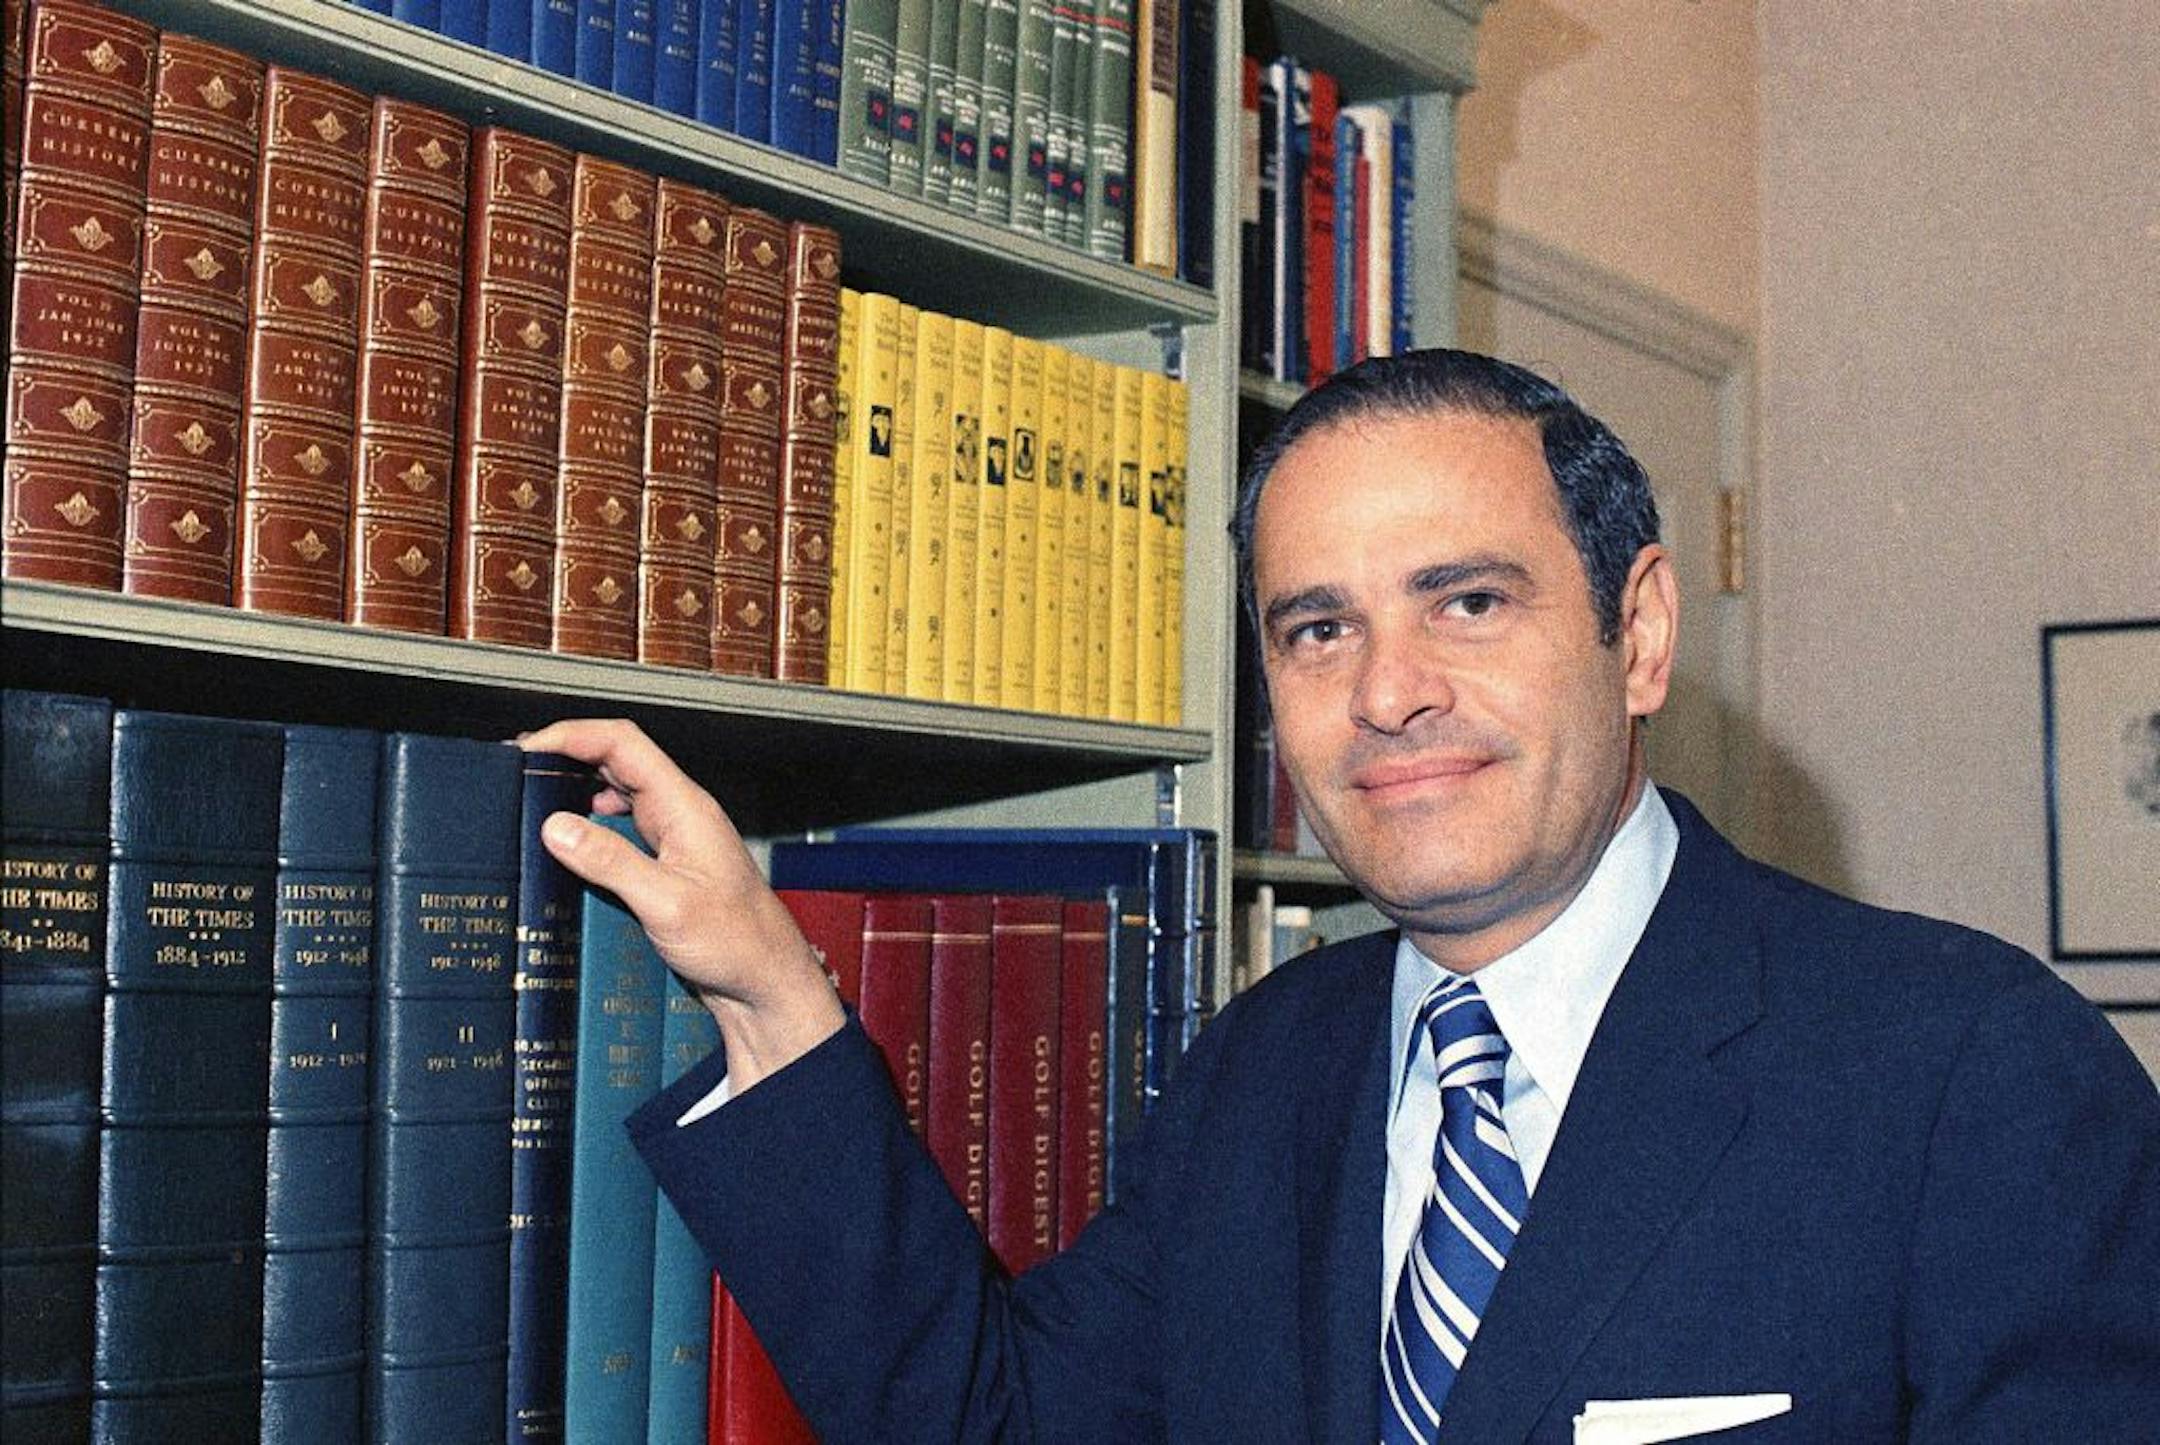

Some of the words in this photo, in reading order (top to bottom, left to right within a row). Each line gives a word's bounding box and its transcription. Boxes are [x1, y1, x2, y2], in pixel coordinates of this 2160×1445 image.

[42, 110, 142, 147] CURRENT
[42, 137, 139, 171] HISTORY
[158, 147, 250, 180] CURRENT
[159, 172, 248, 204] HISTORY
[3, 860, 69, 880] ISTORY
[75, 863, 98, 881] OF
[1, 888, 31, 910] HE
[35, 889, 99, 911] TIMES
[152, 881, 227, 900] HISTORY
[233, 884, 254, 902] OF
[283, 884, 357, 900] HISTORY
[420, 893, 488, 909] HISTORY
[147, 907, 190, 927] THE
[194, 909, 255, 930] TIMES
[282, 909, 325, 928] THE
[330, 910, 373, 928] TIME
[419, 916, 457, 934] THE
[0, 929, 90, 953] 841-1884
[156, 945, 247, 967] 1884-1912
[331, 1022, 337, 1040] I
[458, 1025, 474, 1044] II
[968, 1040, 985, 1127] GOLF
[1034, 1035, 1050, 1119] GOLF
[1087, 1031, 1101, 1116] GOLF
[1087, 1129, 1101, 1213] DIGE
[967, 1144, 983, 1222] DIGE
[1034, 1135, 1050, 1248] DIGEST
